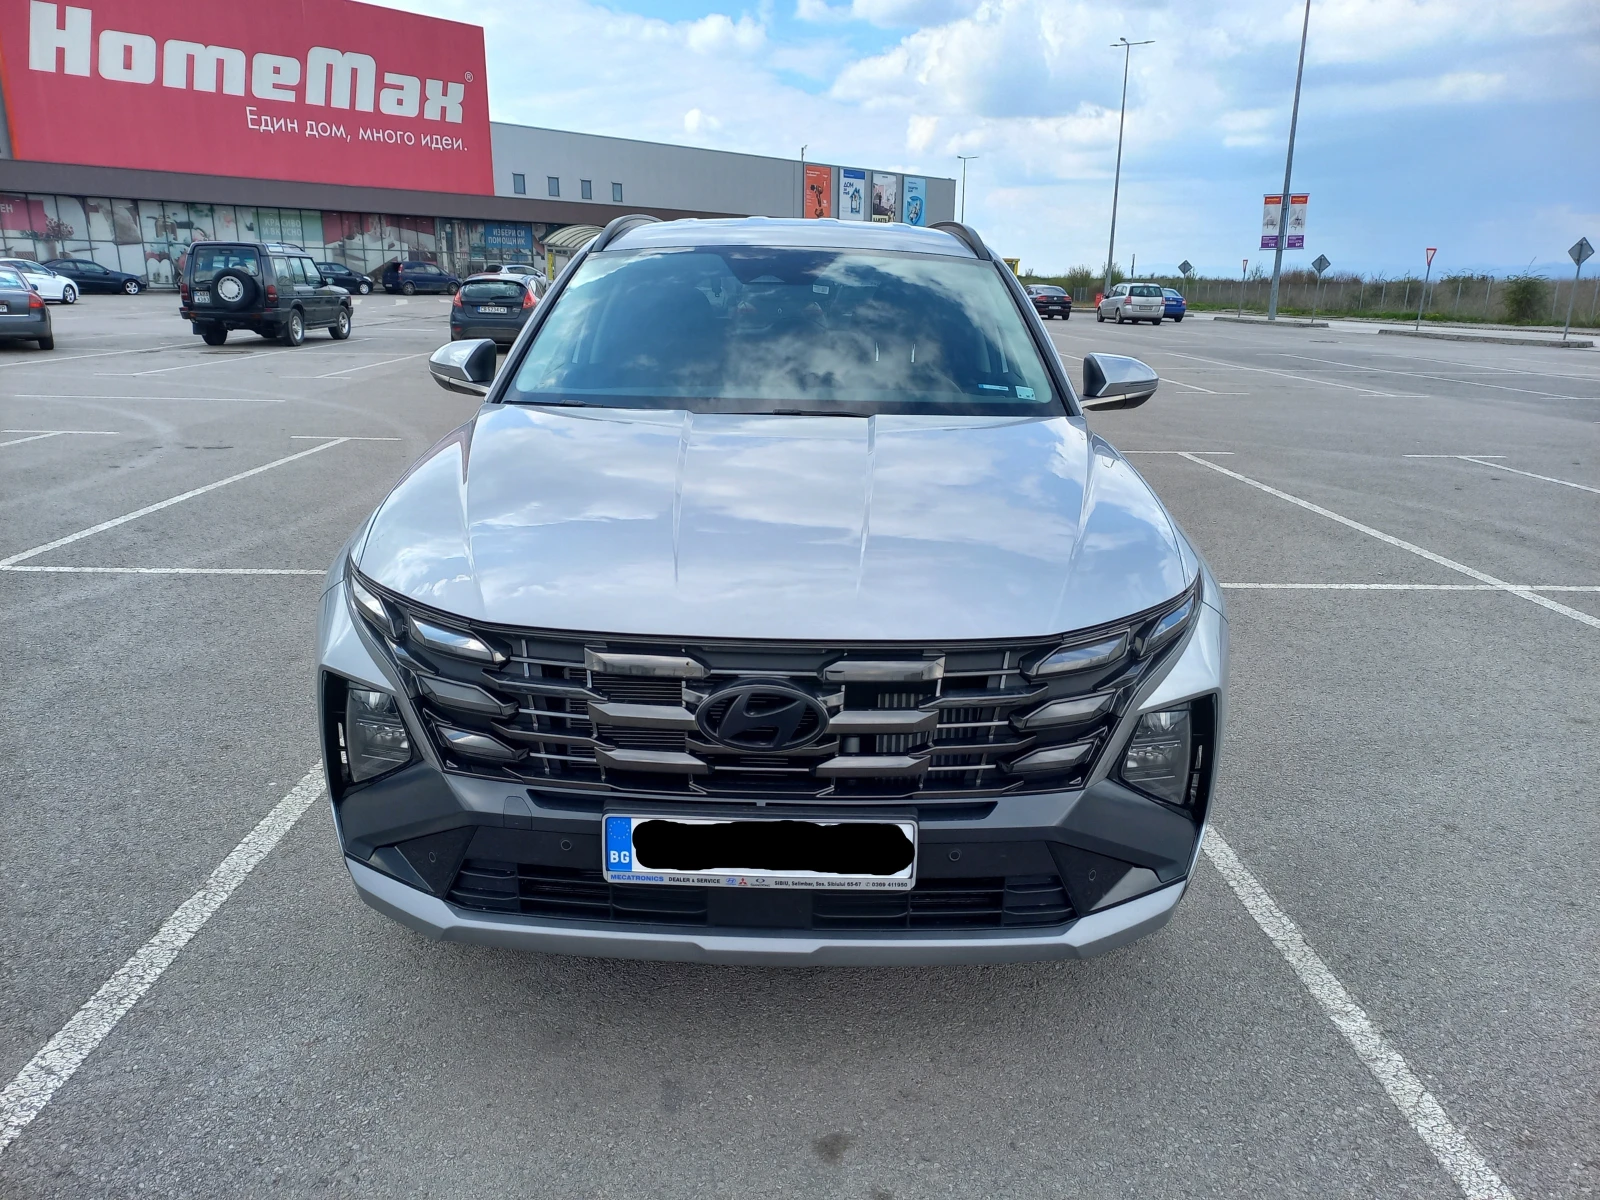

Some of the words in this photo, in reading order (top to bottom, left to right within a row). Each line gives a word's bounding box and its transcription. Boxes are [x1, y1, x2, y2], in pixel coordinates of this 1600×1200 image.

[29, 0, 465, 124] HomeMax
[246, 106, 299, 134] Един
[305, 120, 351, 143] дом,
[358, 126, 415, 146] много
[420, 133, 468, 152] идеи.
[264, 218, 301, 228] КРАСИВО
[262, 227, 269, 235] И
[270, 227, 302, 236] ВКУСНО
[492, 228, 516, 237] ИЗБЕРИ
[488, 236, 526, 246] ПОМОЩНИК
[610, 850, 630, 864] BG
[610, 874, 664, 883] MECATRONICS
[696, 877, 721, 885] SERVICE
